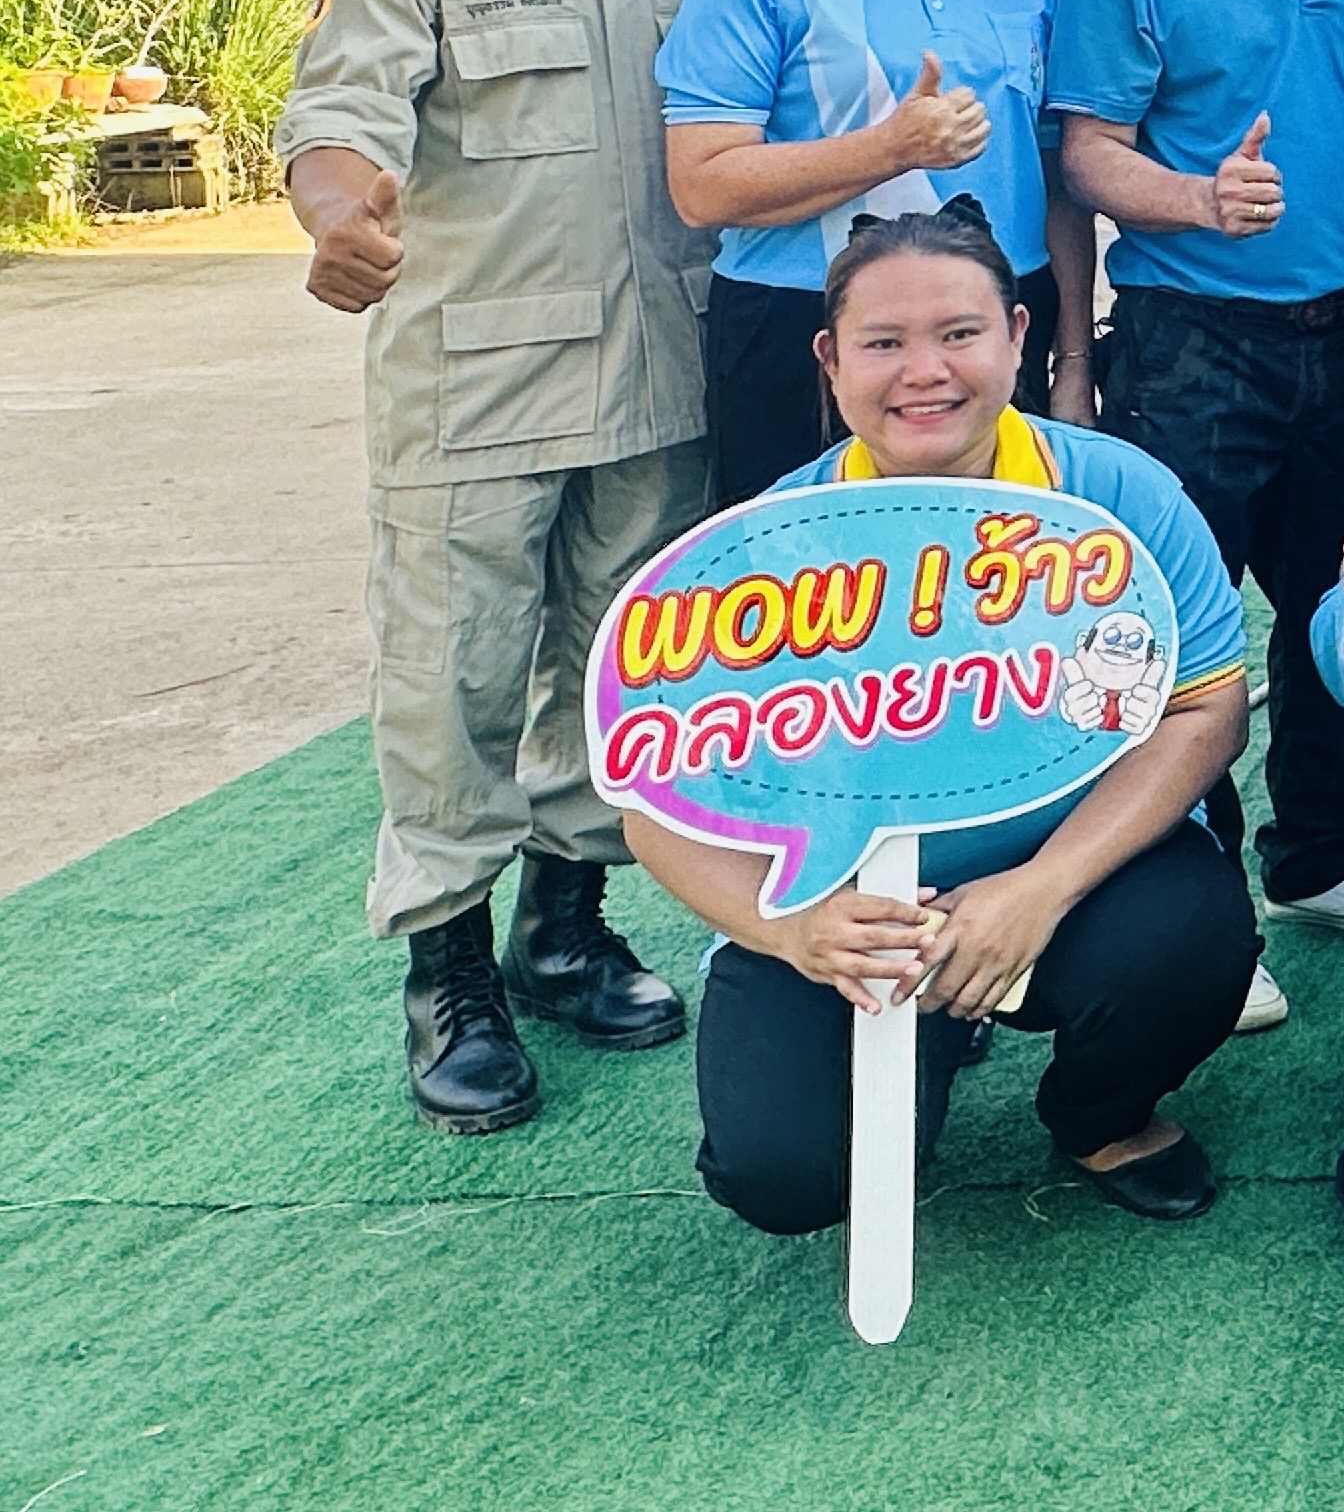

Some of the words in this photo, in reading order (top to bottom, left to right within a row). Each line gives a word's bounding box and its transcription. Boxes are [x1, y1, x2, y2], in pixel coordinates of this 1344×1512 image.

[965, 514, 1133, 626] ว้าว
[605, 646, 1056, 781] คลองยาง
